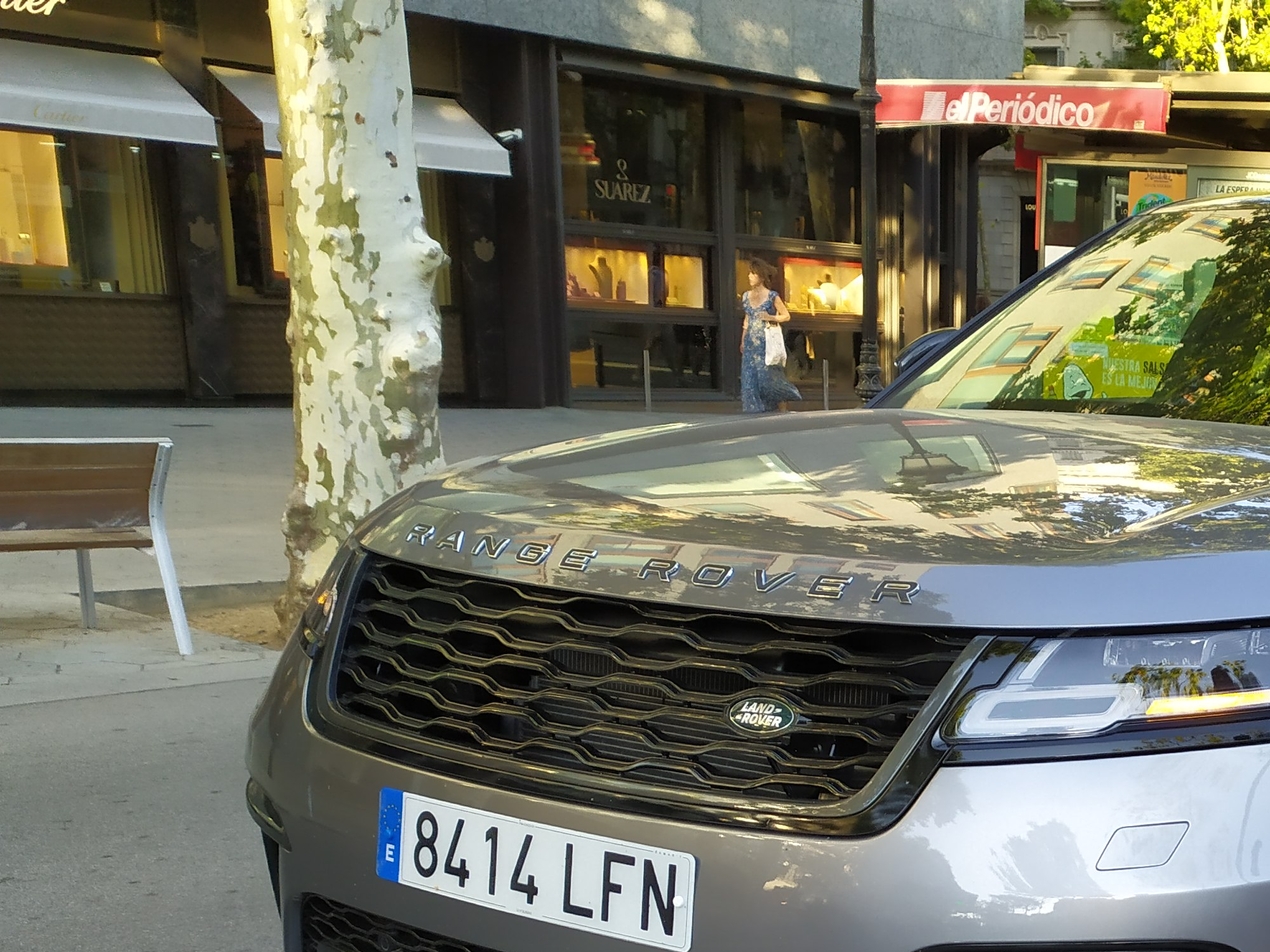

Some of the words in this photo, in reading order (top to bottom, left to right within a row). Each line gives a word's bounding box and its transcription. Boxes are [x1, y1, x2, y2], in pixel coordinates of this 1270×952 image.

[1216, 185, 1225, 194] LA
[1103, 357, 1140, 372] NUESTRA
[1143, 361, 1167, 375] SALS
[1102, 372, 1112, 385] ES
[1115, 374, 1125, 386] LA
[405, 523, 598, 572] RANGE
[636, 557, 921, 604] ROVER
[741, 701, 776, 715] LAND
[741, 712, 783, 728] ROVER
[385, 843, 395, 862] E
[413, 810, 539, 905] 8414
[562, 843, 677, 936] LFN
